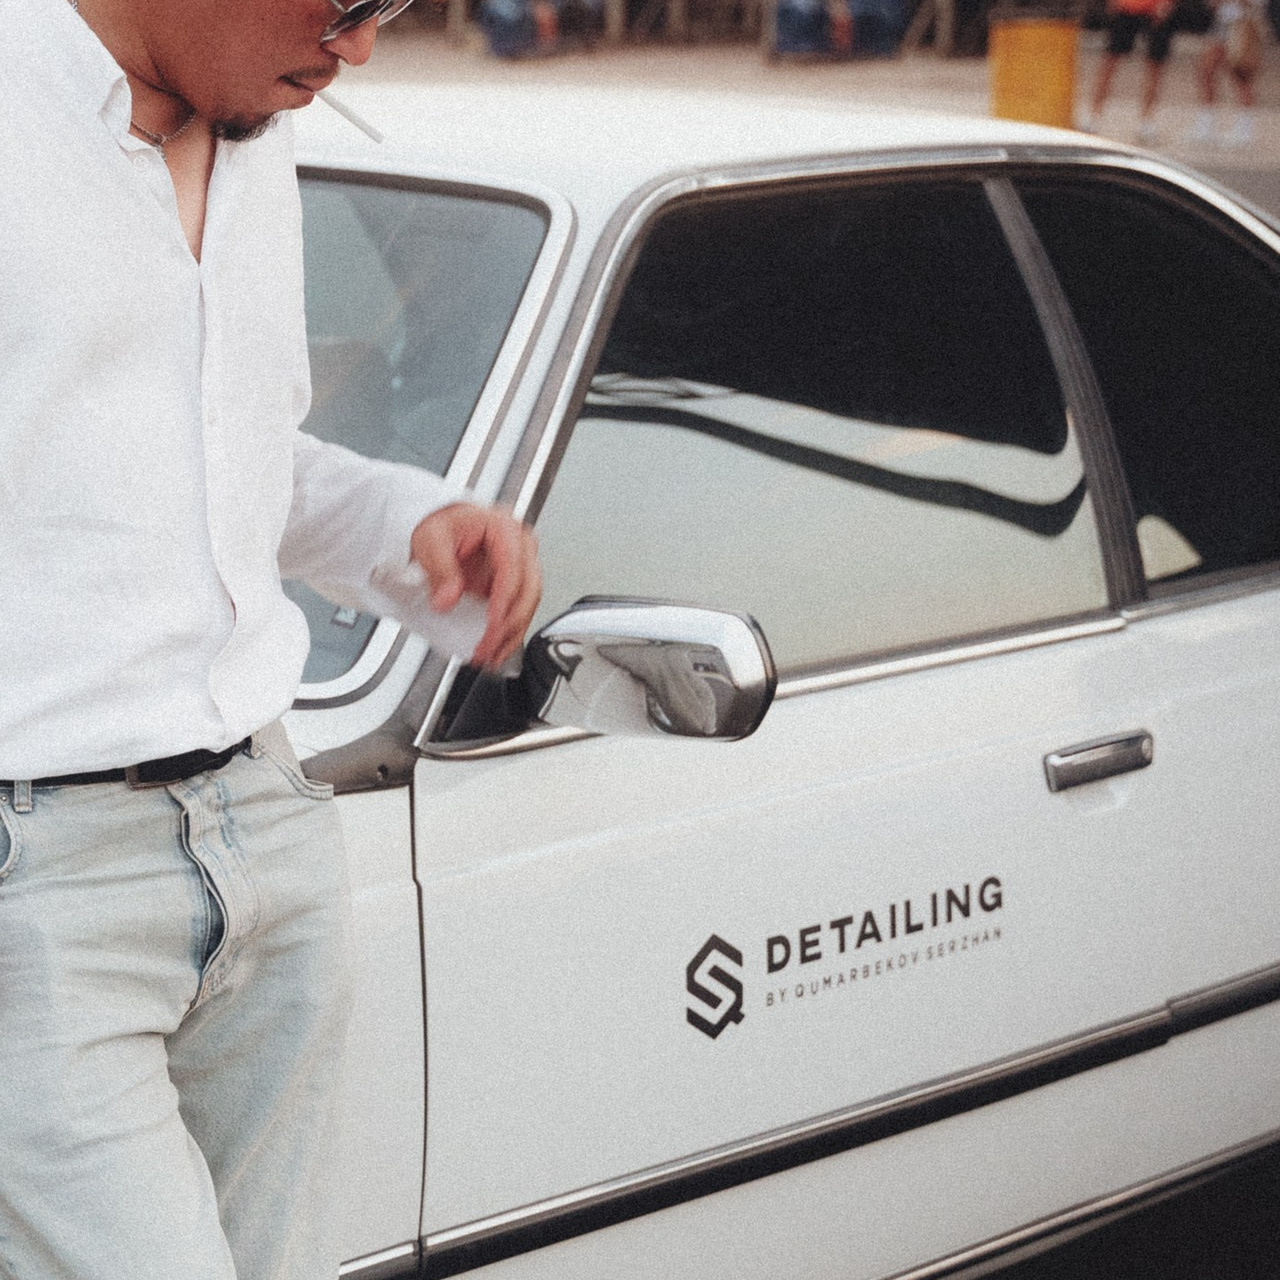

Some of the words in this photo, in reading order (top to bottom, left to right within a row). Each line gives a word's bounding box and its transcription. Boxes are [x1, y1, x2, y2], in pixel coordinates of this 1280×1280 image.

[766, 876, 1004, 974] DETAILING
[766, 988, 787, 1007] BY
[794, 951, 920, 999] QUMARBEKOV
[925, 927, 1002, 960] SERZHAN
